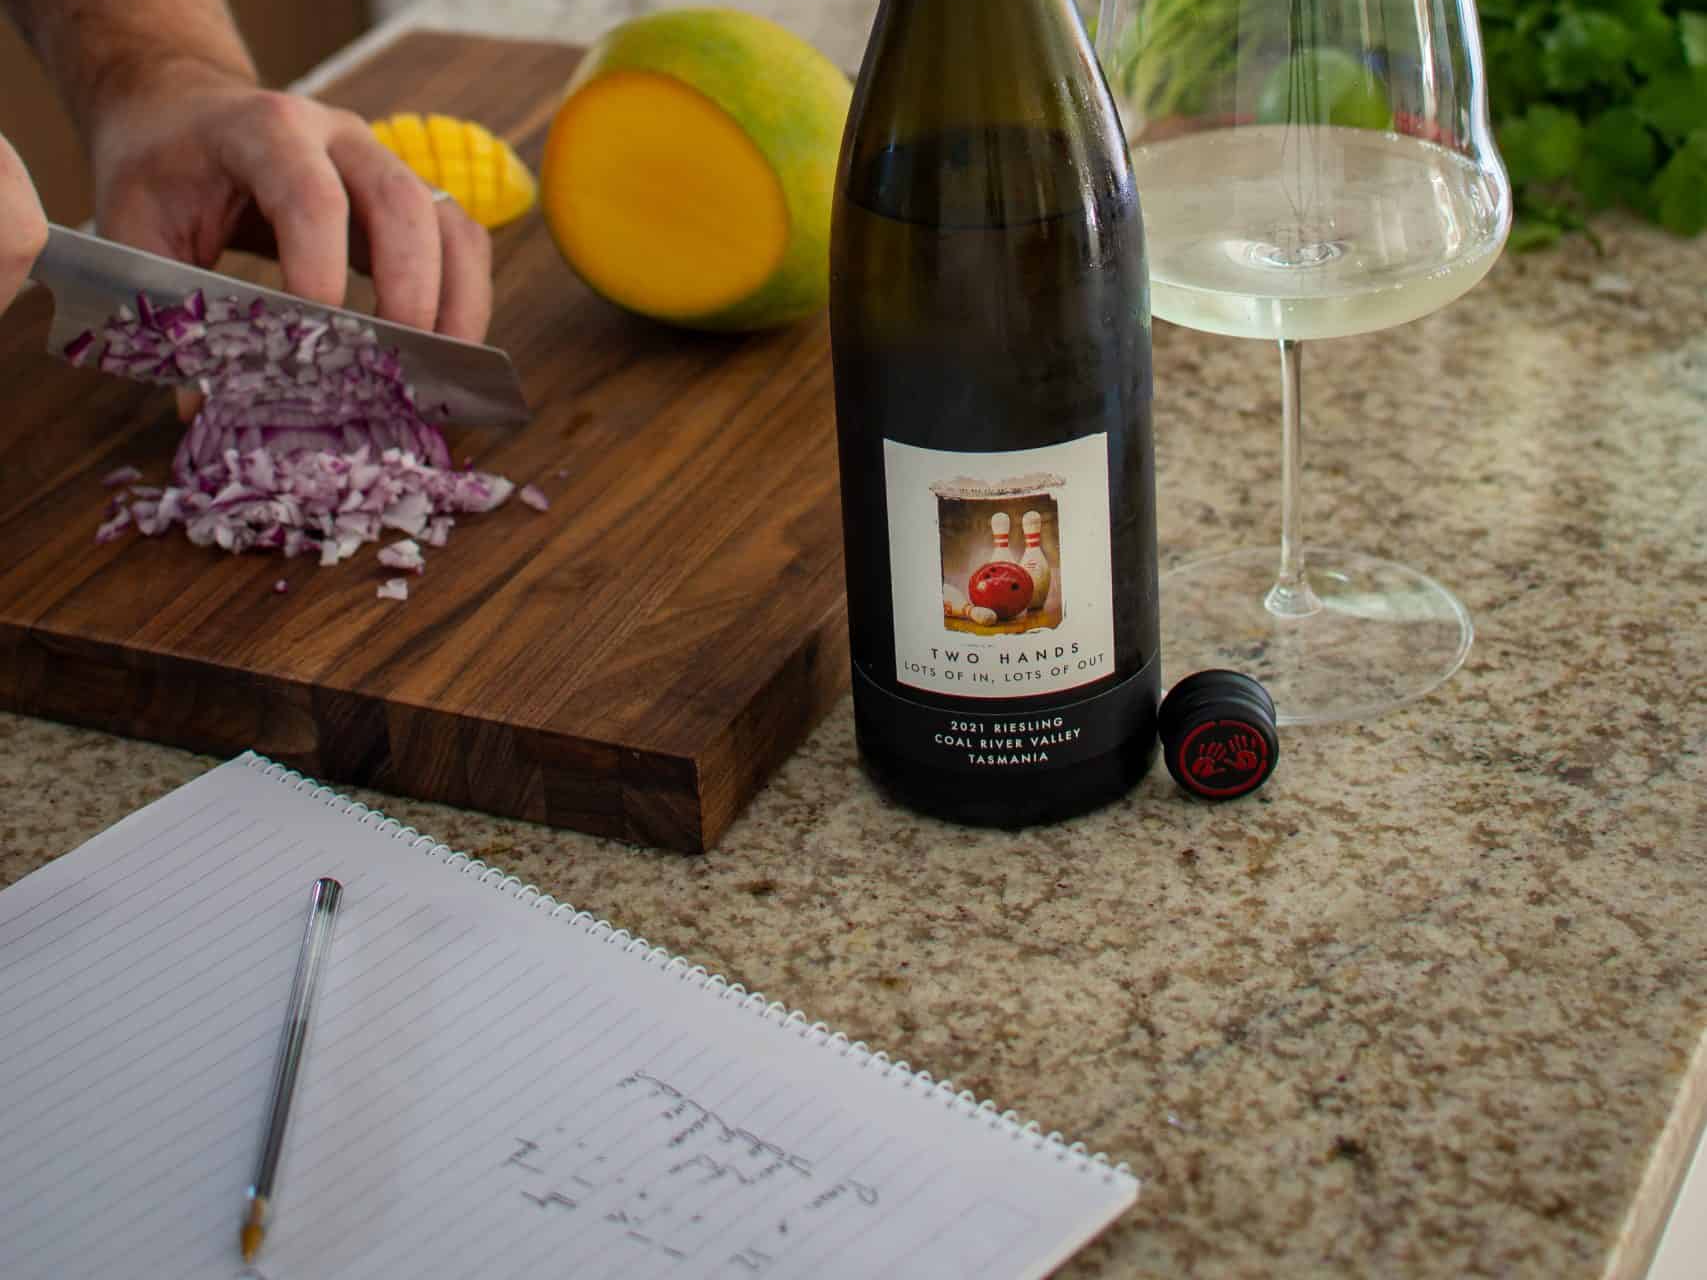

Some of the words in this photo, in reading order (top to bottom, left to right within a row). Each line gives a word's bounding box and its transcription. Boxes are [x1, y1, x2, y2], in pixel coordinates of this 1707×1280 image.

[930, 648, 980, 664] TWO
[999, 642, 1080, 664] HANDS
[903, 659, 936, 677] LOTS
[944, 670, 964, 681] OF
[973, 672, 995, 684] IN,
[1004, 669, 1042, 682] LOTS
[1050, 664, 1069, 677] OF
[1077, 653, 1105, 670] OUT
[951, 720, 985, 733] 2021
[993, 717, 1064, 733] RIESLING
[934, 733, 973, 748] COAL
[980, 738, 1024, 749] RIVER
[1030, 728, 1082, 747] VALLEY
[968, 751, 1049, 765] TASMANIA
